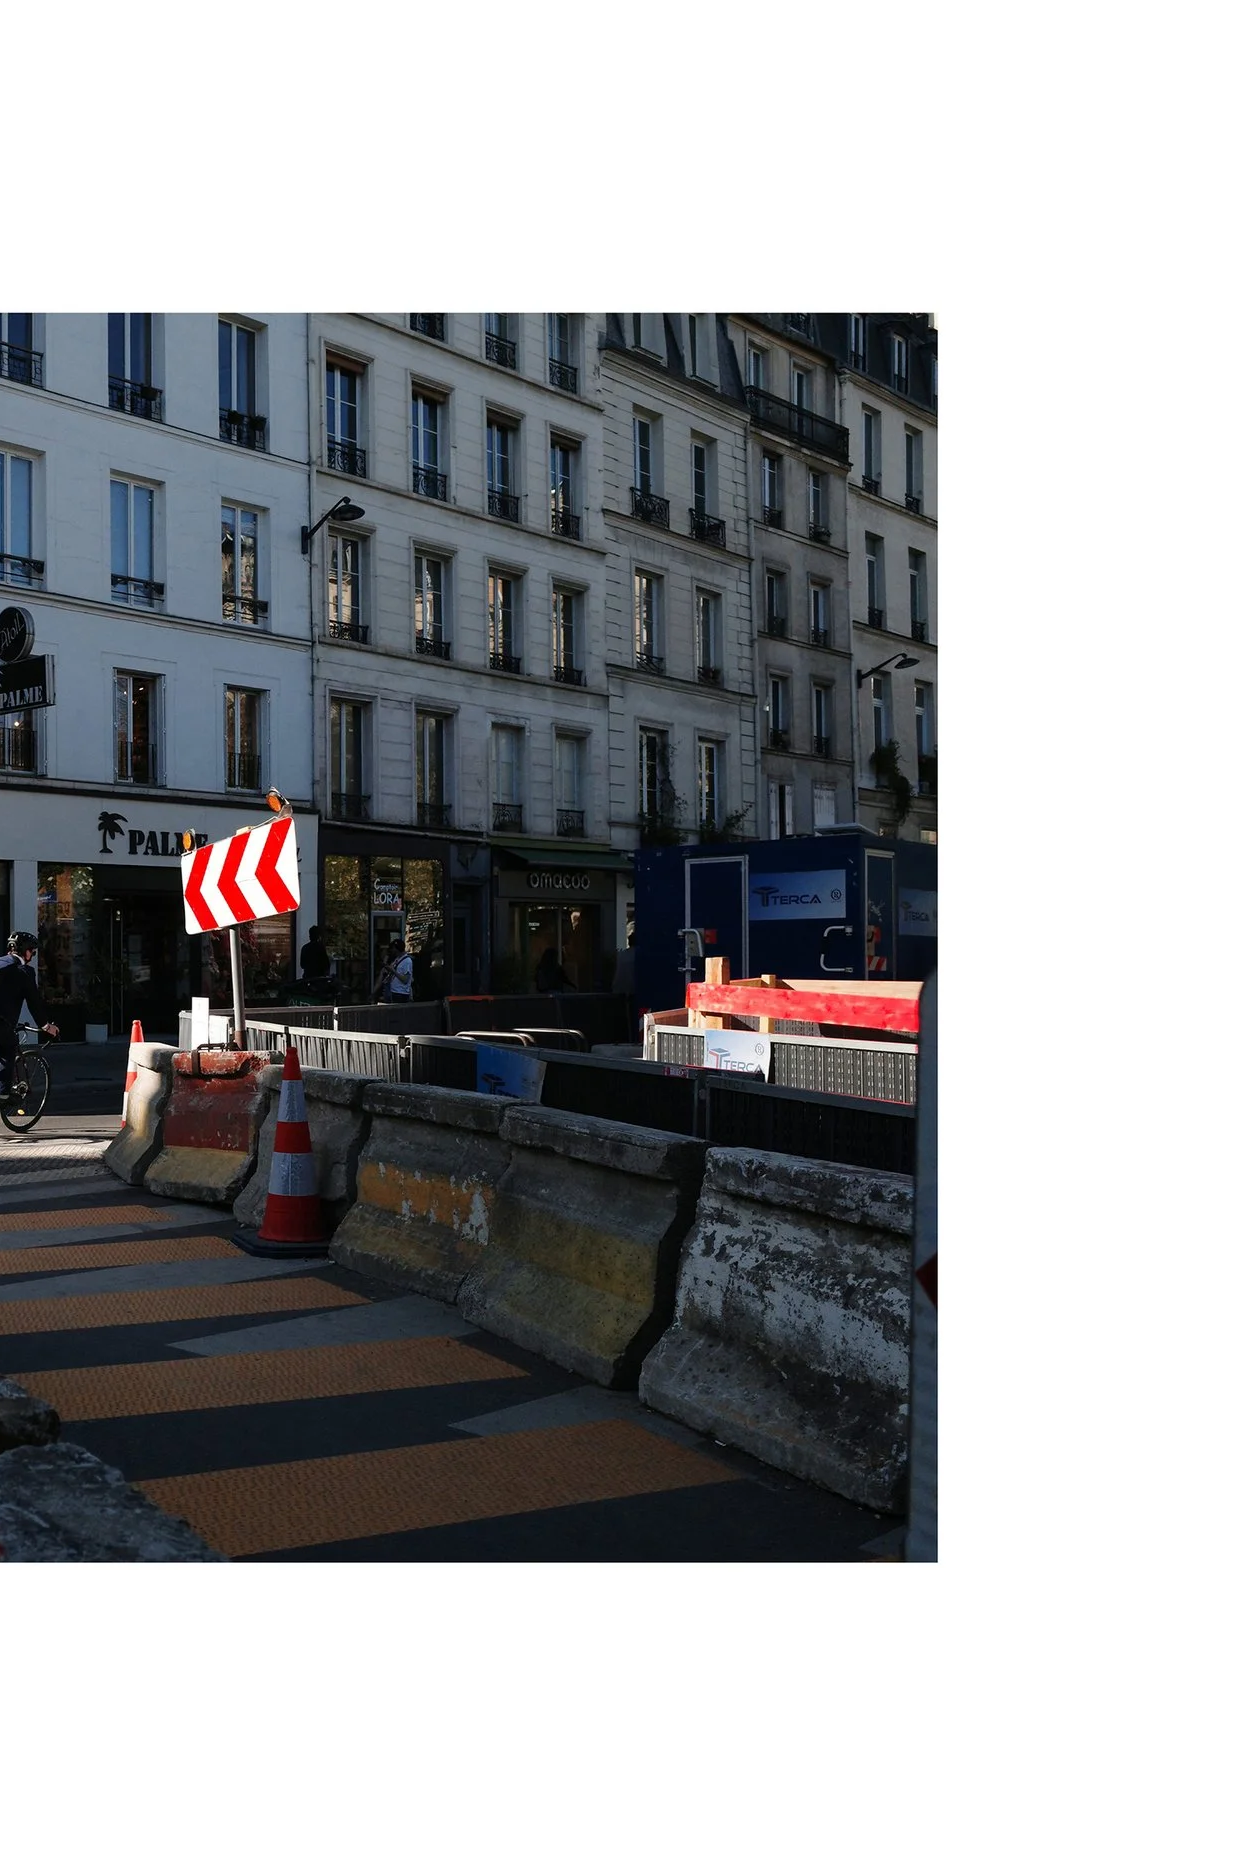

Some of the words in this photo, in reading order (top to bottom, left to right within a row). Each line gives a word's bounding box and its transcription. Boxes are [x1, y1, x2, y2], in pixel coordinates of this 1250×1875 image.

[0, 685, 43, 709] PALME
[374, 892, 400, 905] LORA
[771, 894, 822, 905] TERCA
[724, 1059, 764, 1073] TERCA
